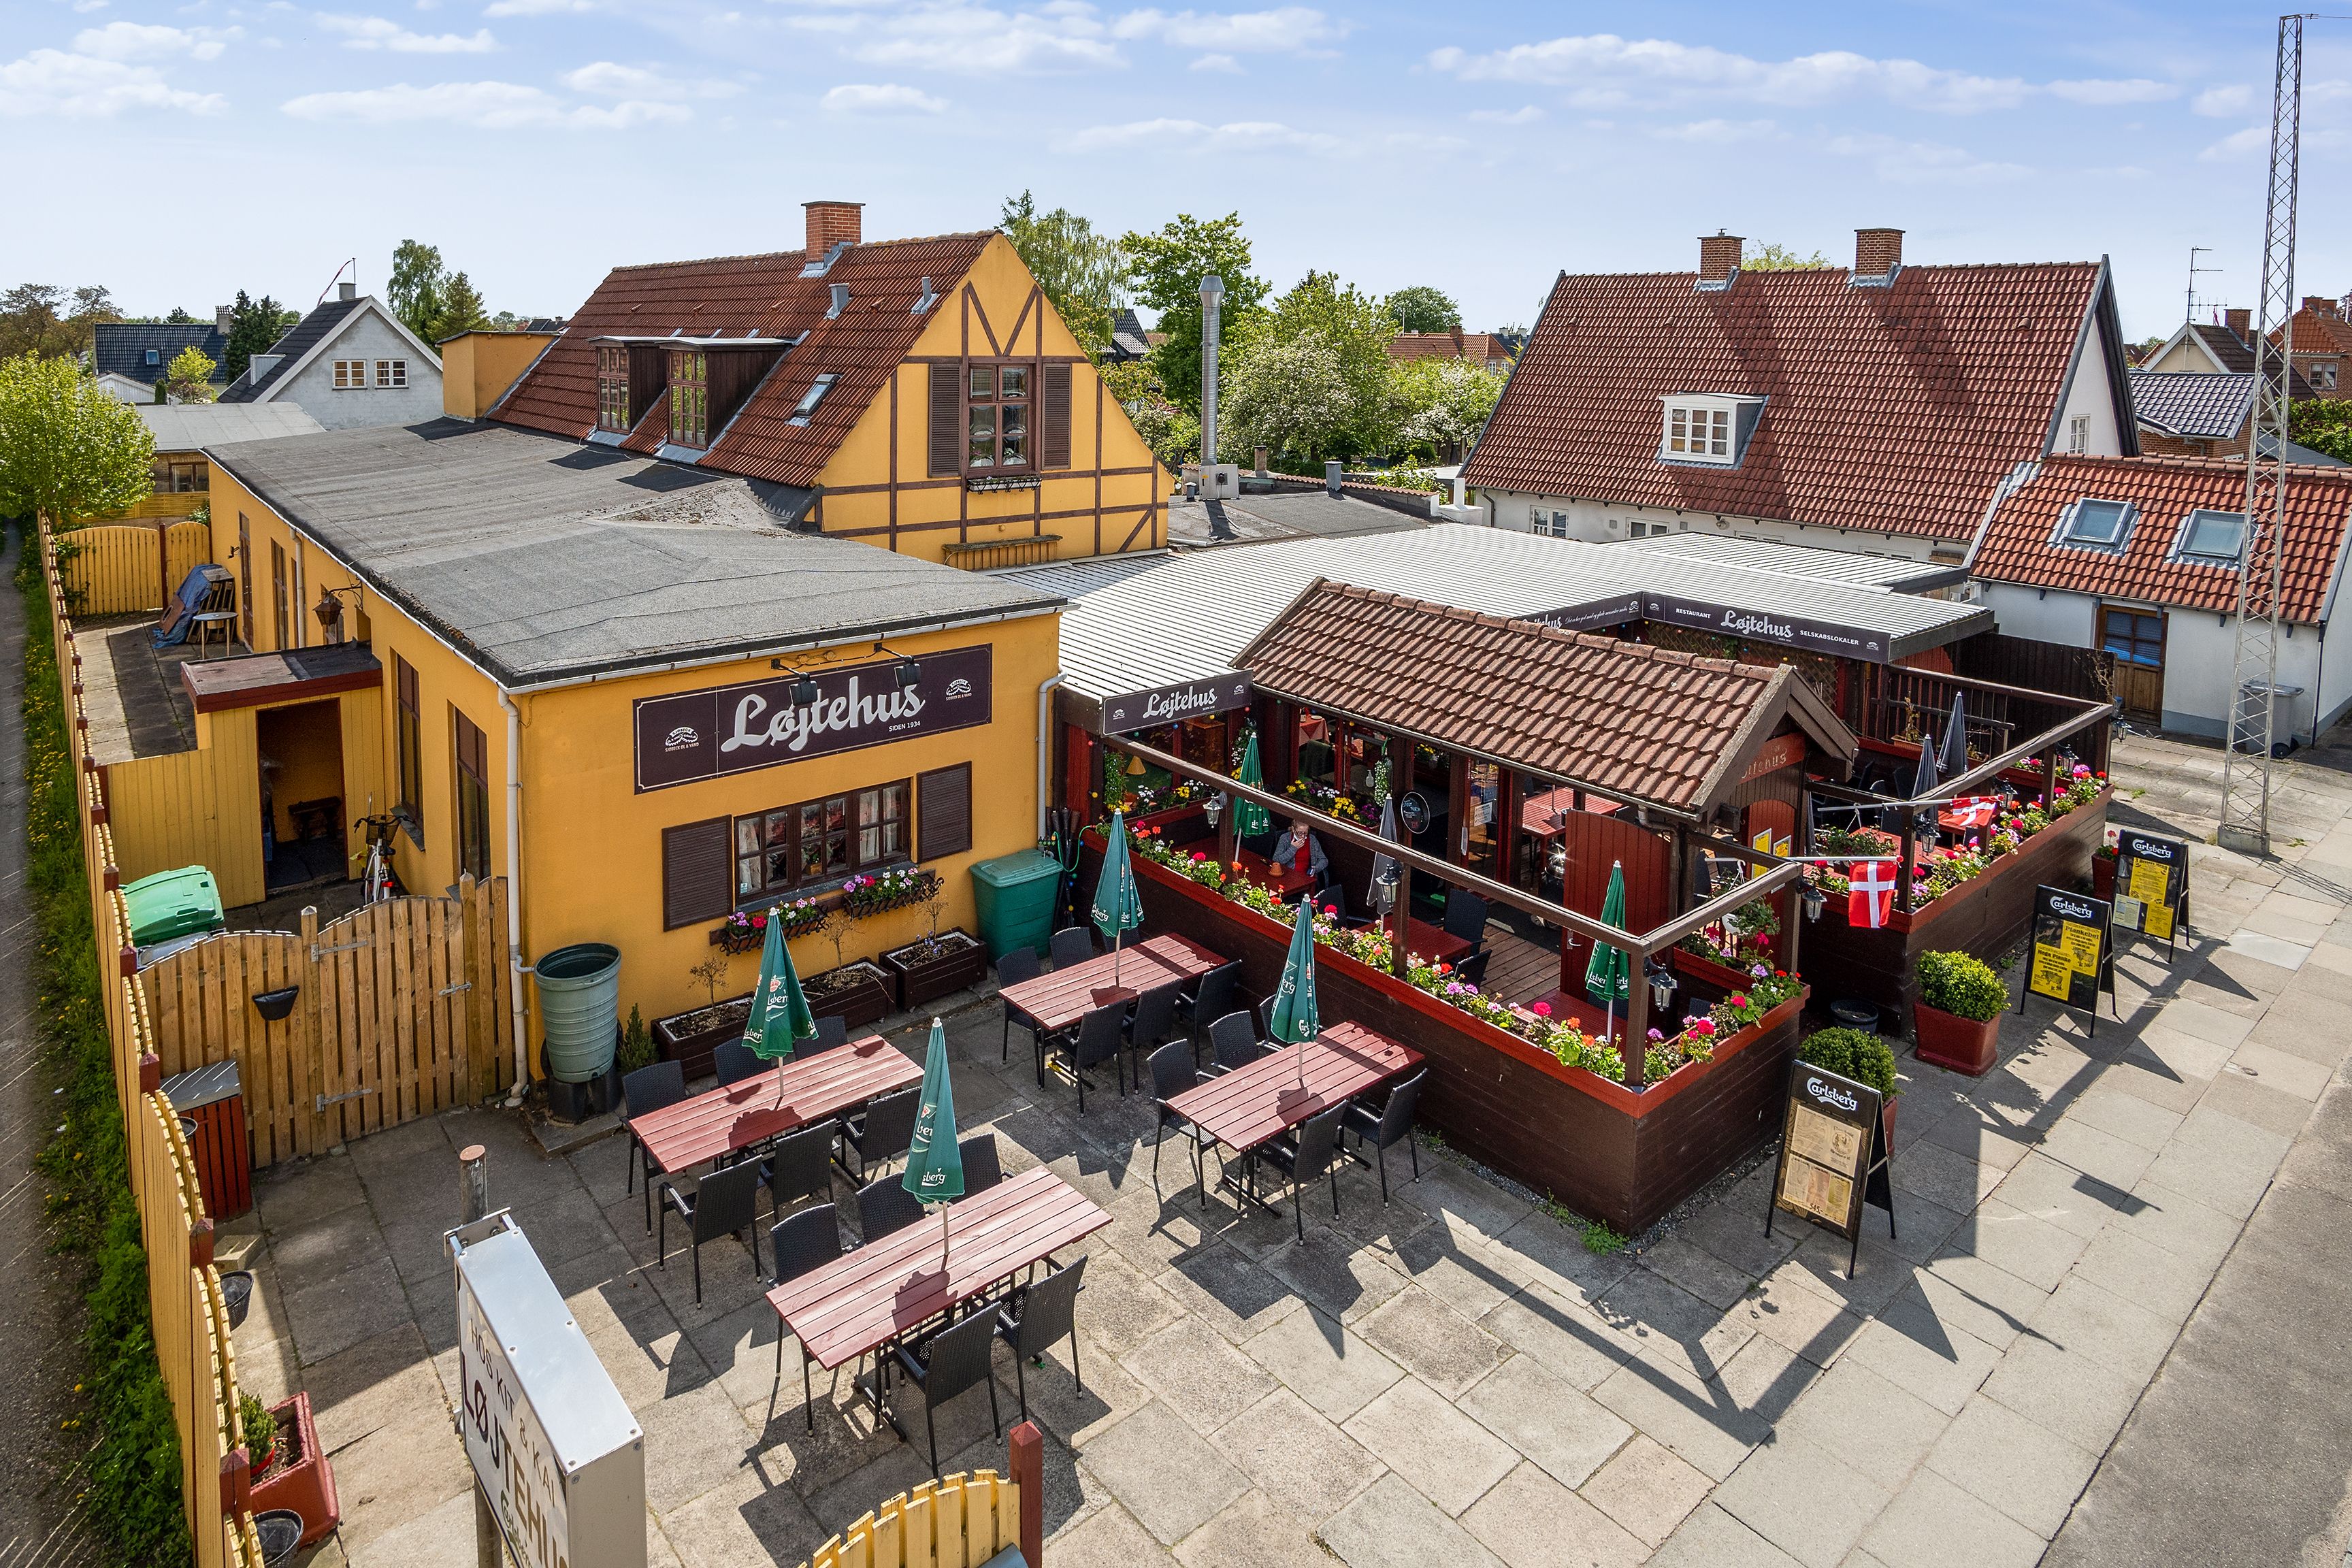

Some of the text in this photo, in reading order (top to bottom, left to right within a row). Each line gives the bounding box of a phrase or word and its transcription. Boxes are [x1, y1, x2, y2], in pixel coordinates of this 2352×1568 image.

[1676, 608, 1712, 619] RESTAURANT
[1720, 610, 1794, 638] Løjtehus
[1799, 630, 1859, 646] SELSKABSLOKALER
[721, 676, 926, 751] Løjtehus
[1143, 686, 1218, 719] Løjtehus
[889, 720, 921, 732] SIDEN 1934
[2132, 838, 2172, 858] Carlsberg
[2049, 896, 2092, 919] Carlsberg
[1807, 1077, 1858, 1111] Carlsberg
[923, 1171, 946, 1185] sberg
[470, 1318, 555, 1509] HOS KIT & KAI
[461, 1350, 569, 1568] LØJTEHU
